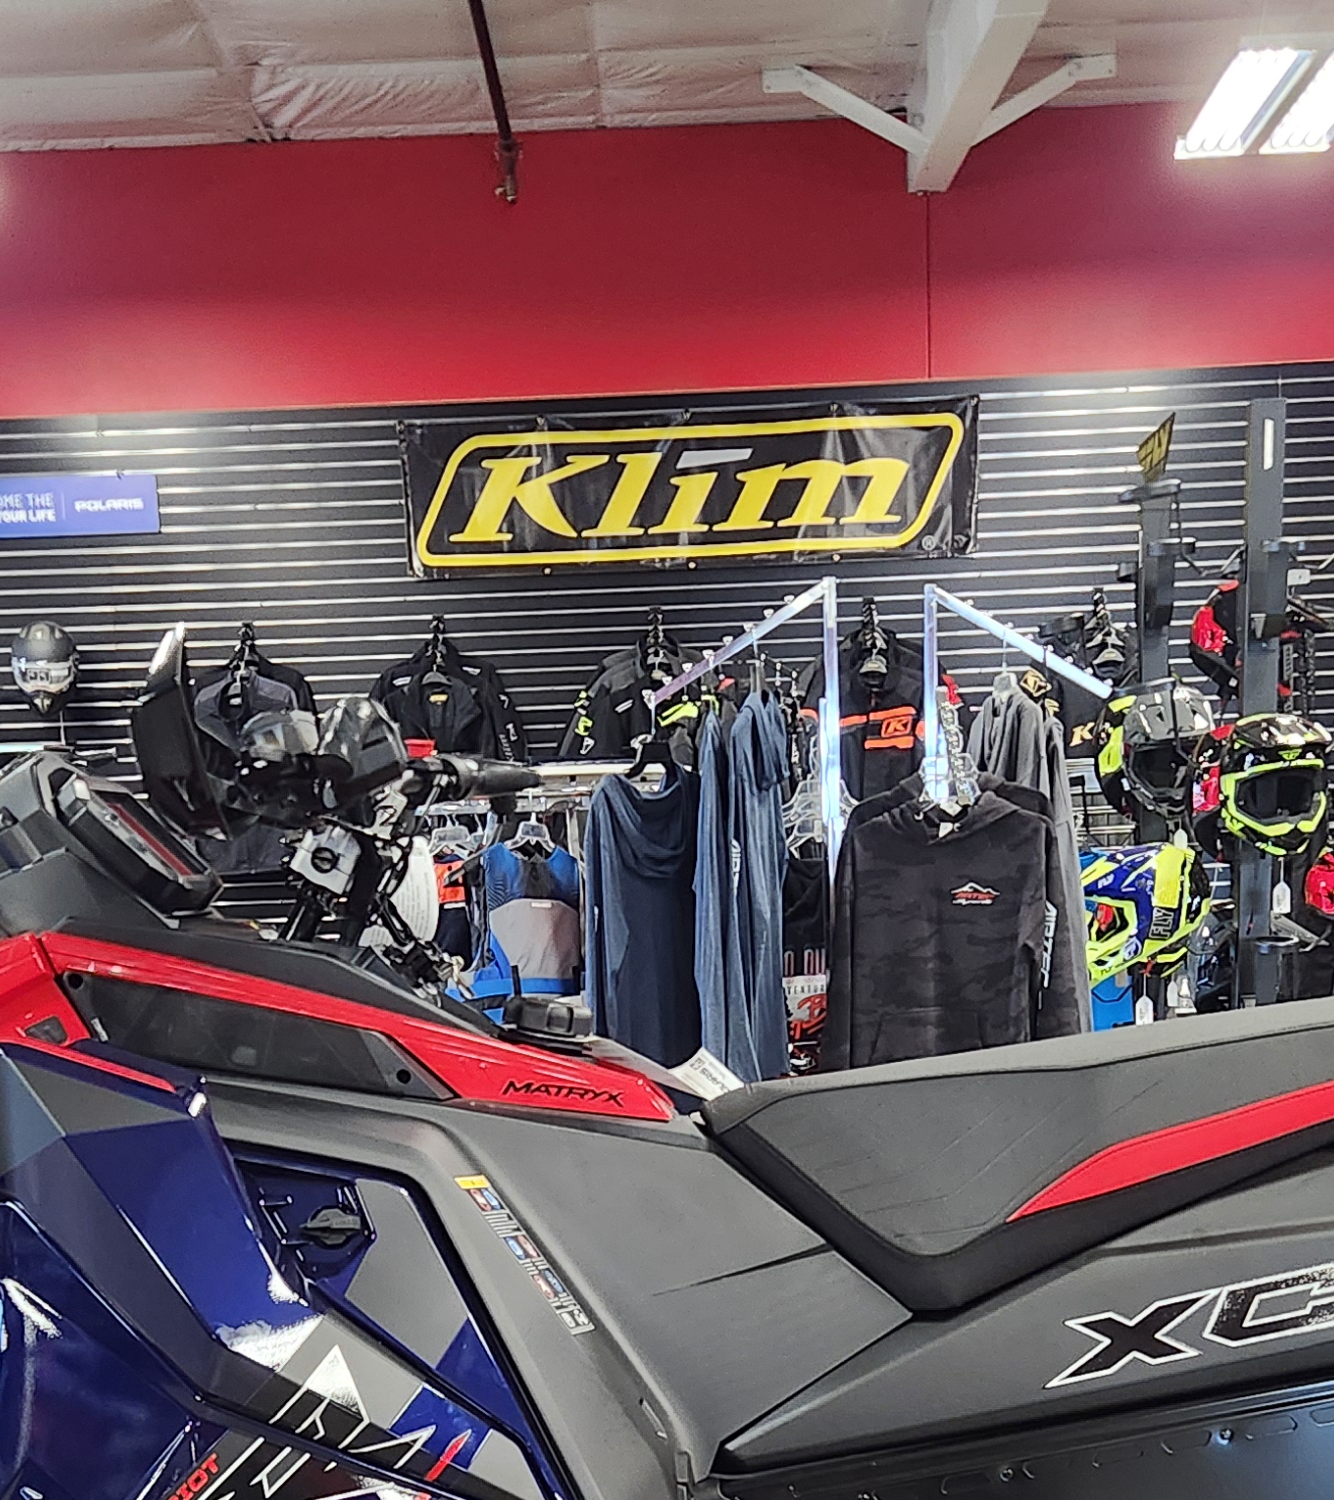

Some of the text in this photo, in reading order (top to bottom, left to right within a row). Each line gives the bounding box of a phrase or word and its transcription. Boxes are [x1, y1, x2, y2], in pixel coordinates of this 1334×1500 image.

[27, 491, 55, 508] THE
[449, 446, 909, 542] Klim
[74, 497, 145, 513] POLARIS
[28, 508, 57, 523] LIFE
[502, 1079, 625, 1108] MATRYX
